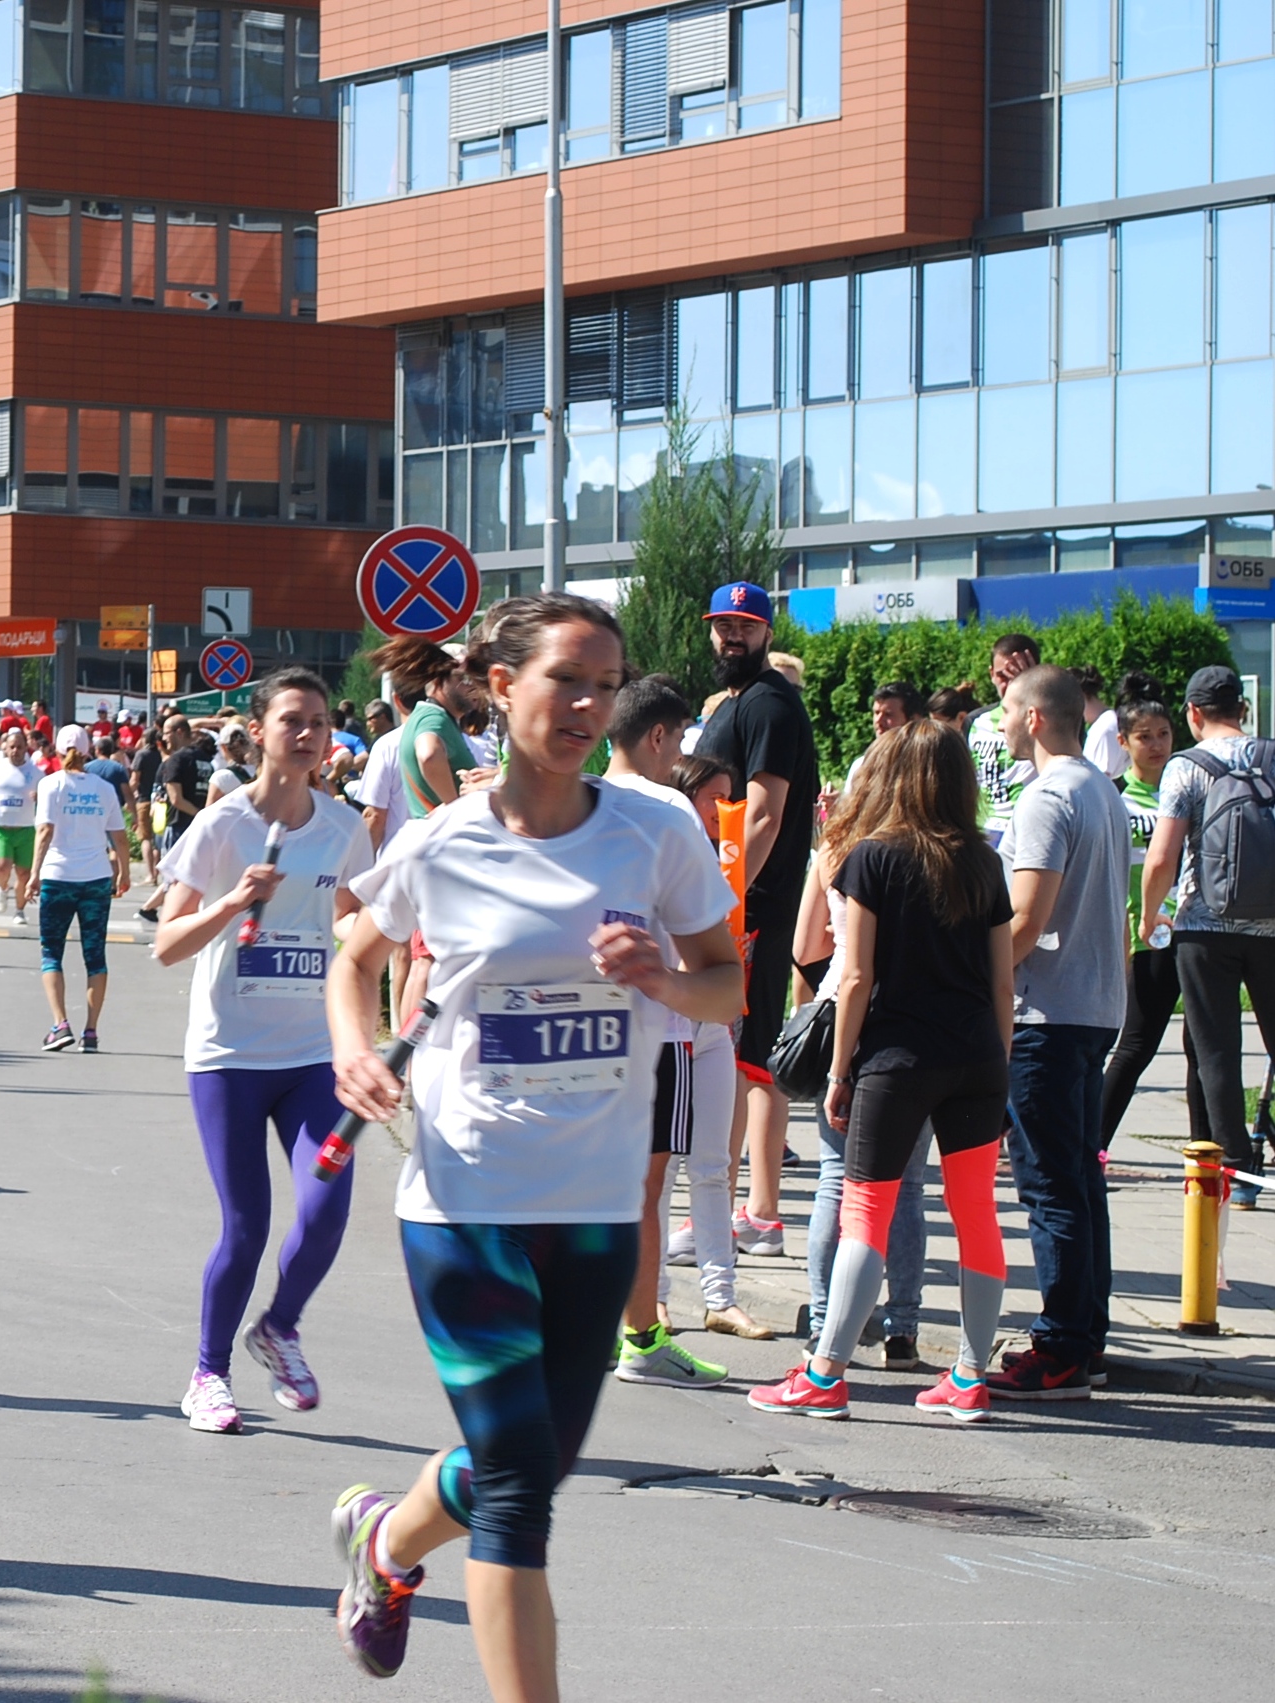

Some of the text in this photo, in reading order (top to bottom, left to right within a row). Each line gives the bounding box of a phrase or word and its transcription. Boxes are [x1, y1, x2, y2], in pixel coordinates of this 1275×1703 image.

[885, 592, 914, 609] ОББ
[63, 805, 104, 816] runners
[272, 950, 323, 975] 170B
[533, 1015, 622, 1057] 171B
